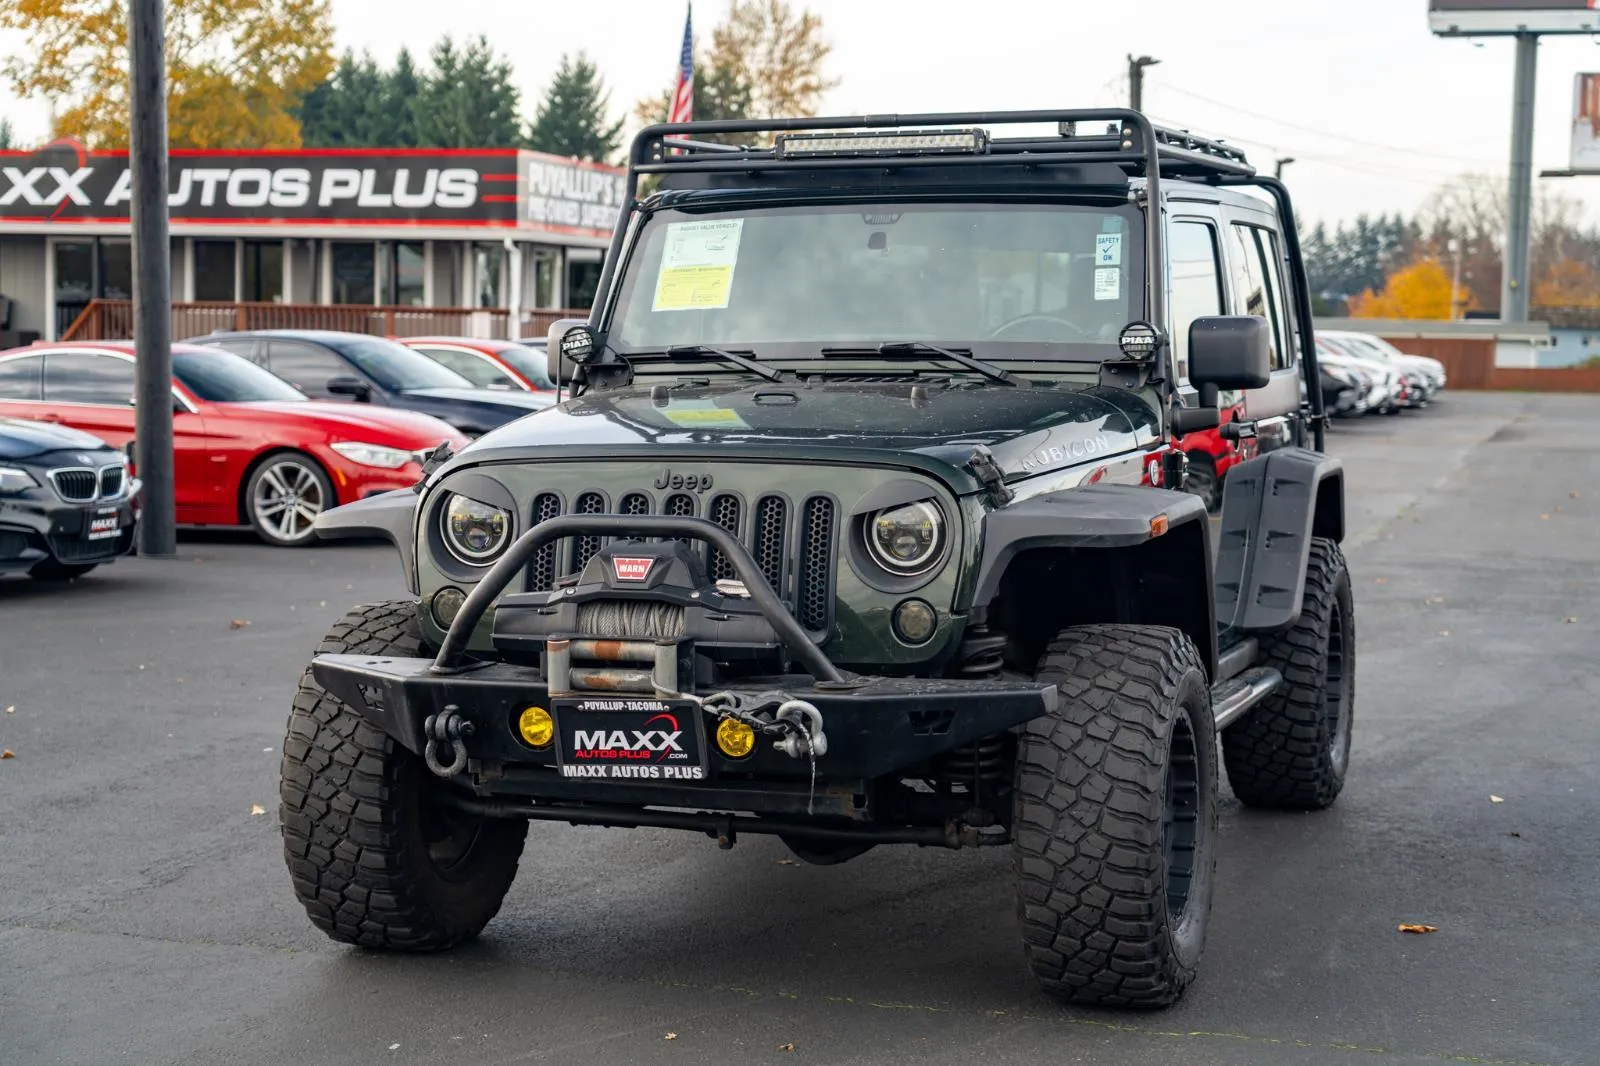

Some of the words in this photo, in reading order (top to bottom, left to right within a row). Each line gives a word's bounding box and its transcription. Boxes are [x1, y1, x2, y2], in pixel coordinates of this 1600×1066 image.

[318, 168, 479, 208] PLUS
[562, 339, 590, 351] PIAA
[1121, 336, 1153, 345] PIAA
[654, 469, 714, 493] Jeep
[619, 564, 645, 573] WARN
[574, 730, 684, 751] MAXX
[575, 749, 617, 759] AUTOS
[619, 750, 651, 759] PLUS
[563, 765, 607, 778] MAXX
[611, 766, 660, 779] AUTOS
[664, 767, 703, 780] PLUS
